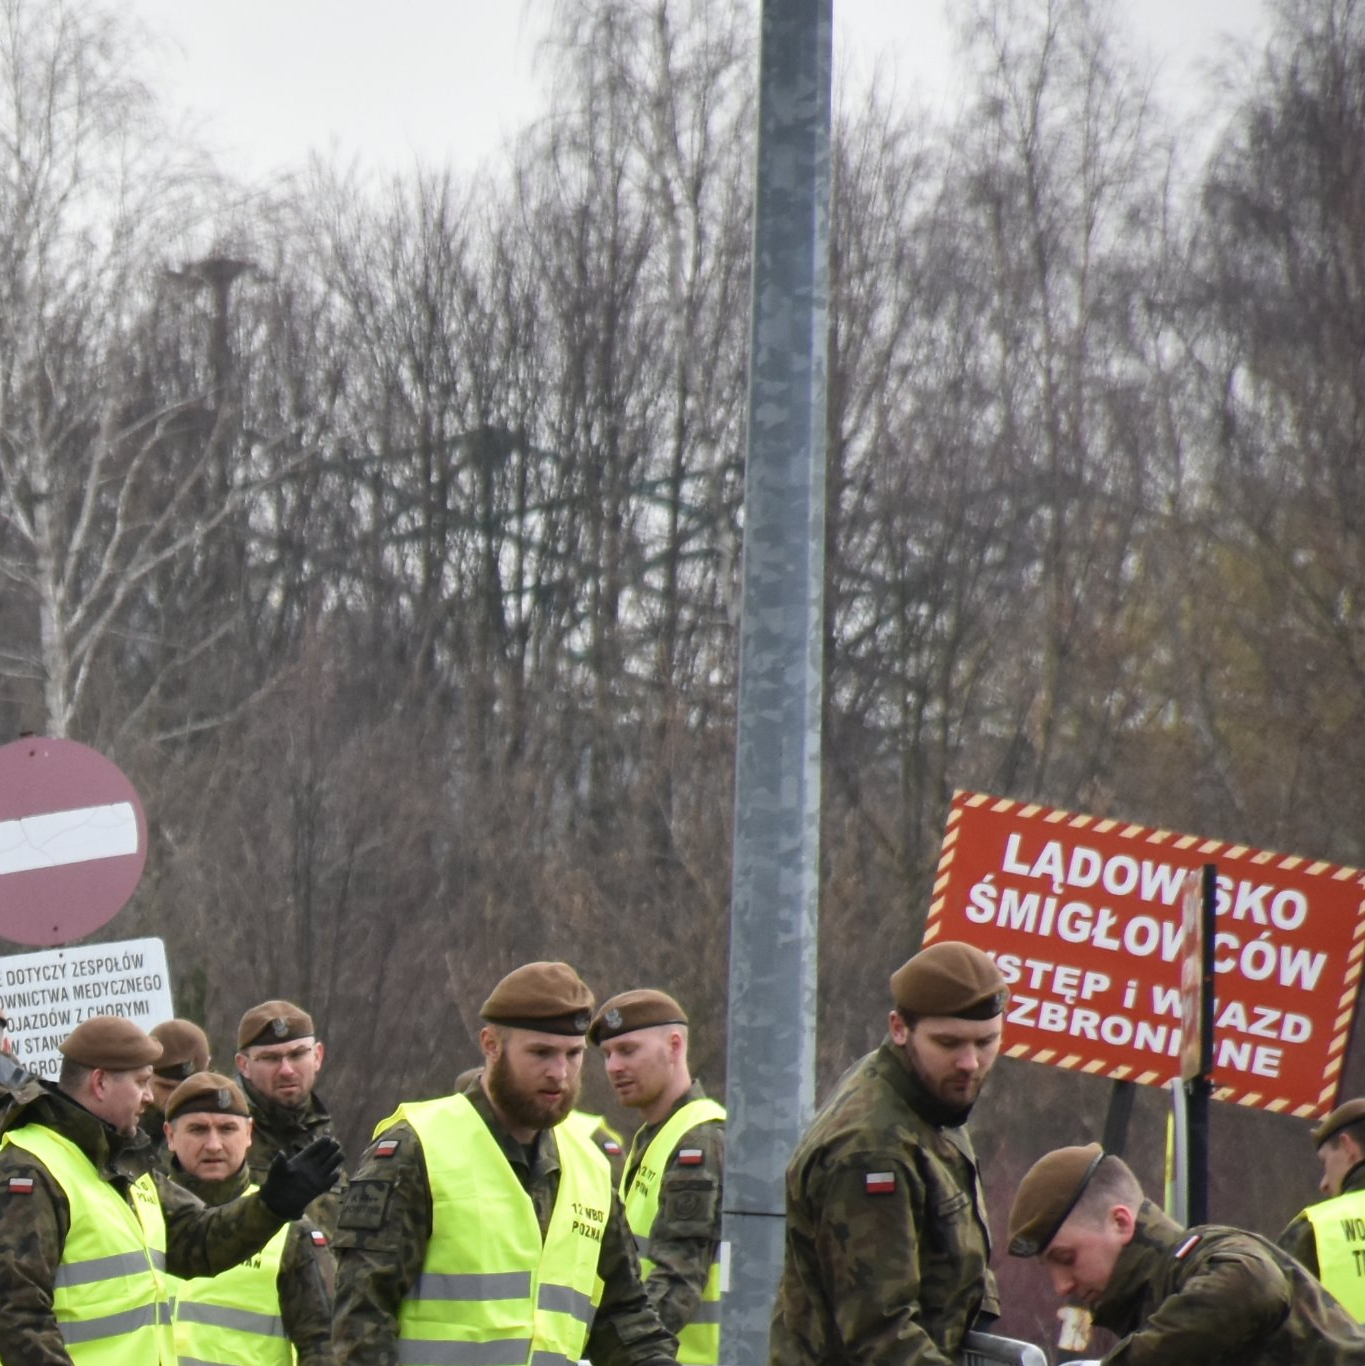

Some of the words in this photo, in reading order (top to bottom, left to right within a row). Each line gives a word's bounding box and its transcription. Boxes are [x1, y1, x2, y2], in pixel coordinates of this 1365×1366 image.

[1001, 833, 1309, 931] LĄDOWSKO
[6, 963, 67, 987] DOTYCZY
[72, 952, 144, 977] ZESPOŁÓW
[72, 974, 162, 1000] MEDYCZNEGO
[985, 951, 1111, 1005] STĘP
[1122, 979, 1140, 1009] i
[1152, 985, 1313, 1043] WAZD
[6, 1008, 70, 1033] OJAZDÓW
[75, 1008, 83, 1024] Z
[571, 1220, 601, 1243] POZNA
